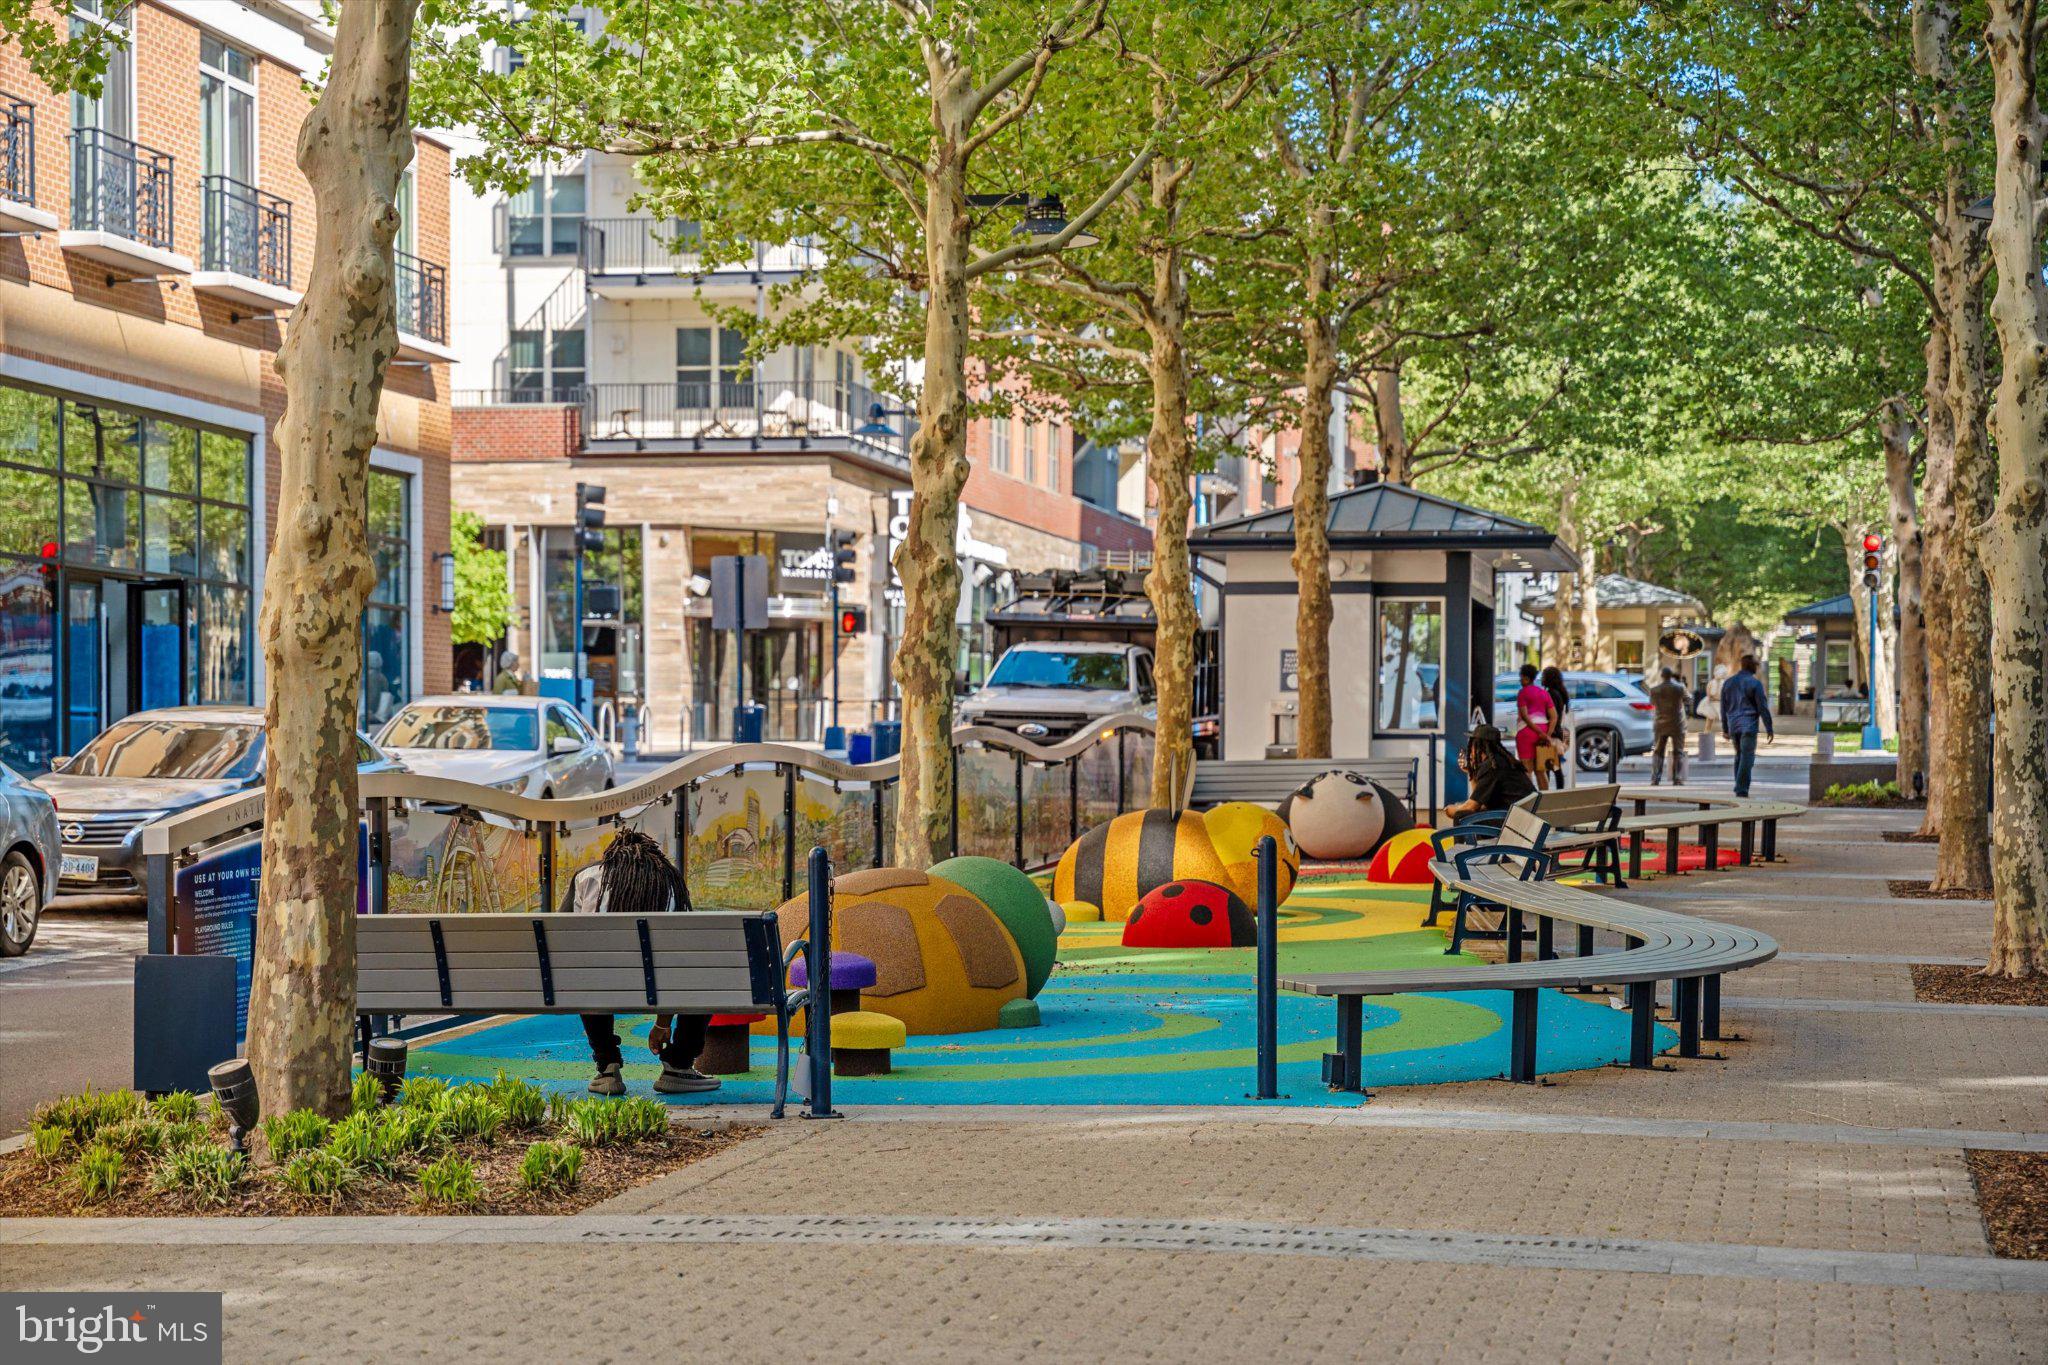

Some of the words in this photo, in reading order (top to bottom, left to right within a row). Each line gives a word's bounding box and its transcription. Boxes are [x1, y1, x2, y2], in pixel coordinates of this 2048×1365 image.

[594, 796, 628, 811] NATIONAL
[632, 785, 656, 802] HARBOR
[194, 874, 206, 884] USE
[208, 872, 216, 882] AT
[217, 870, 234, 880] YOUR
[235, 868, 250, 878] OWN
[250, 866, 261, 876] RIS
[194, 888, 215, 898] WELCOME
[194, 923, 221, 934] PLAYGROUND
[221, 920, 234, 930] RULES
